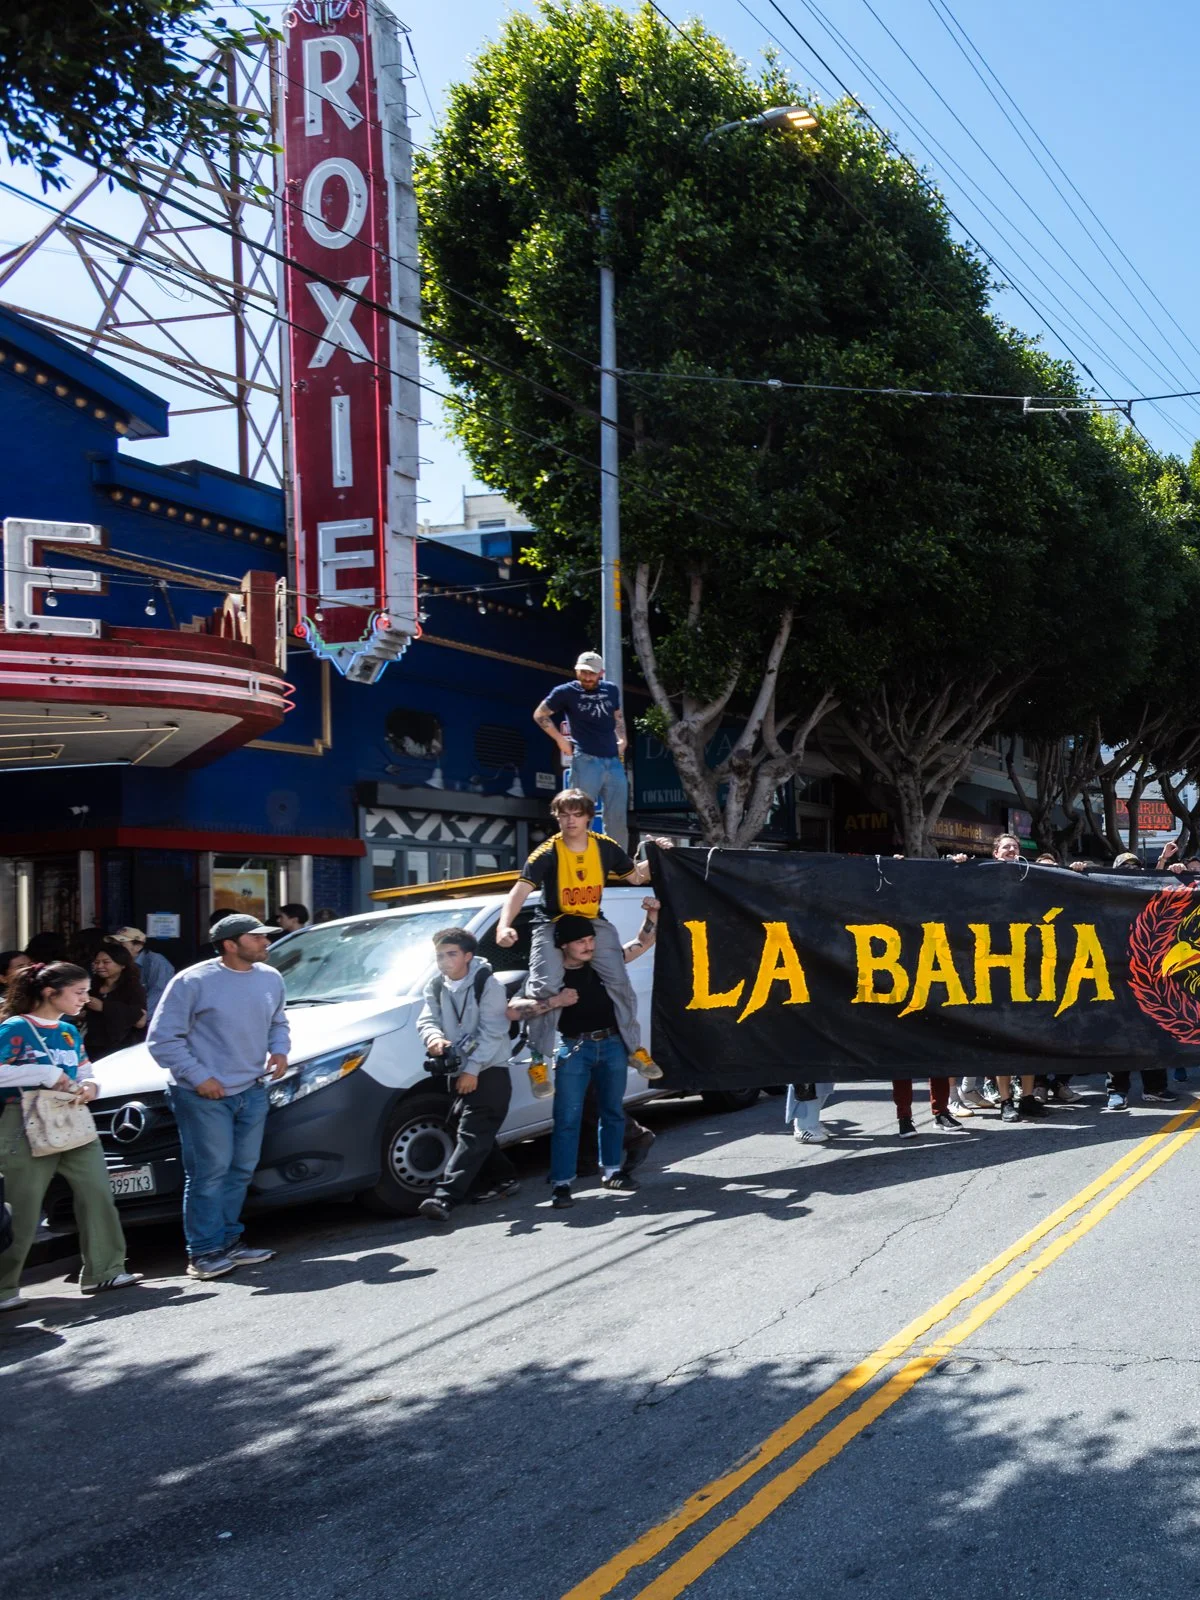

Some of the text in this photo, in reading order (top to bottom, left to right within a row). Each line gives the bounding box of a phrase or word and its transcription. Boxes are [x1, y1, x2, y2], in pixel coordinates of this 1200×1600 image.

[303, 34, 376, 611] ROXIE
[844, 811, 889, 831] ATM
[683, 919, 811, 1024] LA
[844, 906, 1116, 1018] BAHÍA
